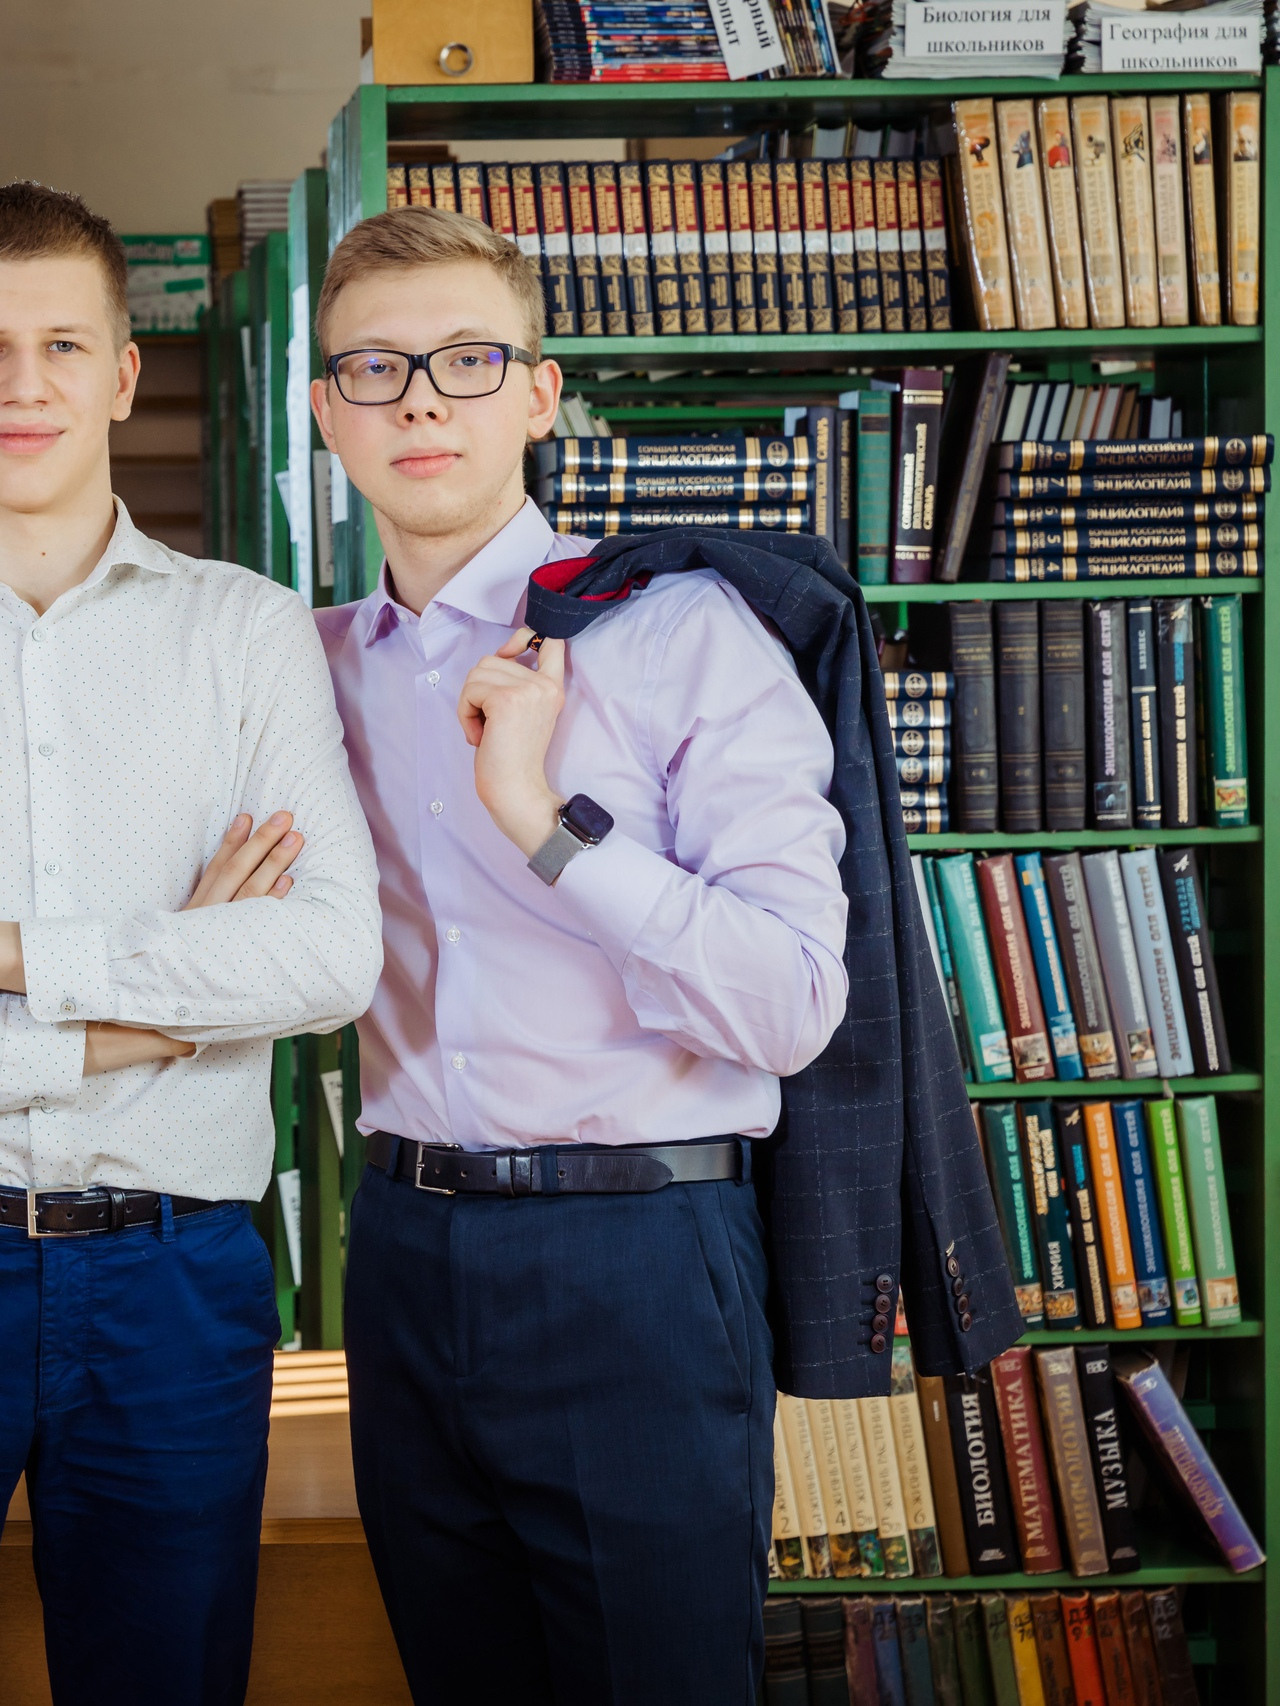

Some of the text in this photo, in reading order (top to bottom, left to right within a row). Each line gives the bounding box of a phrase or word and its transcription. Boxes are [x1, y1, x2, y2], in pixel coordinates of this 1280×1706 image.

[922, 7, 1051, 24] Биология для
[1109, 23, 1248, 43] География для
[927, 37, 1045, 53] школьников
[1121, 54, 1239, 70] школьников
[816, 417, 828, 461] СЛОВАРЬ
[1095, 442, 1195, 454] БОЛЬШАЯ РОССИЙСКАЯ
[637, 454, 737, 467] ЭНЦИКЛОПЕДИЯ
[1096, 453, 1194, 466] ЭНЦИКЛОПЕДИЯ
[635, 485, 735, 498] ЭНЦИКЛОПЕДИЯ
[1092, 478, 1192, 491] ЭНЦИКЛОПЕДИЯ
[630, 513, 730, 526] ЭНЦИКЛОПЕДИЯ
[1086, 506, 1185, 520] ЭНЦИКЛОПЕДИЯ
[1047, 534, 1061, 544] 5
[1088, 535, 1187, 549] ЭНЦИКЛОПЕДИЯ
[1046, 562, 1060, 573] 4
[1087, 554, 1185, 564] БОЛЬШАЯ РОССИЙСКАЯ
[1087, 562, 1186, 576] ЭНЦИКЛОПЕДИЯ
[1138, 628, 1148, 670] БИЗНЕС
[1099, 609, 1115, 776] ЭНЦИКЛОПЕДИЯ ДЛЯ ДЕТЕЙ
[1220, 606, 1236, 773] ЭНЦИКЛОПЕДИЯ ДЛЯ ДЕТЕЙ
[1059, 864, 1075, 902] ДЕТЕЙ
[991, 864, 1032, 1029] ЭНЦИКЛОПЕДИЯ ДЛЯ ДЕТЕЙ
[1137, 865, 1182, 1062] ЭНЦИКЛОПЕДИЯ ДЛЯ ДЕТЕЙ
[1071, 931, 1098, 1029] ЭНЦИКЛОПЕДИЯ
[1001, 1114, 1017, 1152] ДЕТЕЙ
[1093, 1111, 1109, 1150] ДЕТЕЙ
[1124, 1109, 1157, 1273] ЭНЦИКЛОПЕДИЯ ДЛЯ ДЕТЕЙ
[1013, 1182, 1034, 1279] ЭНЦИКЛОПЕДИЯ
[1103, 1180, 1127, 1276] ЭНЦИКЛОПЕДИЯ
[1170, 1176, 1191, 1272] ЭНЦИКЛОПЕДИЯ
[1206, 1174, 1227, 1271] ЭНЦИКЛОПЕДИЯ
[1047, 1241, 1066, 1290] ХИМИЯ
[961, 1392, 997, 1528] БИОЛОГИЯ
[1006, 1377, 1045, 1542] МАТЕМАТИКА
[1053, 1383, 1094, 1541] МИФОЛОГИЯ
[1094, 1408, 1129, 1512] МУЗЫКА
[780, 1516, 791, 1534] 2
[835, 1510, 847, 1527] 4
[913, 1508, 926, 1525] 6
[1072, 1625, 1082, 1642] 9
[1157, 1623, 1172, 1640] 12
